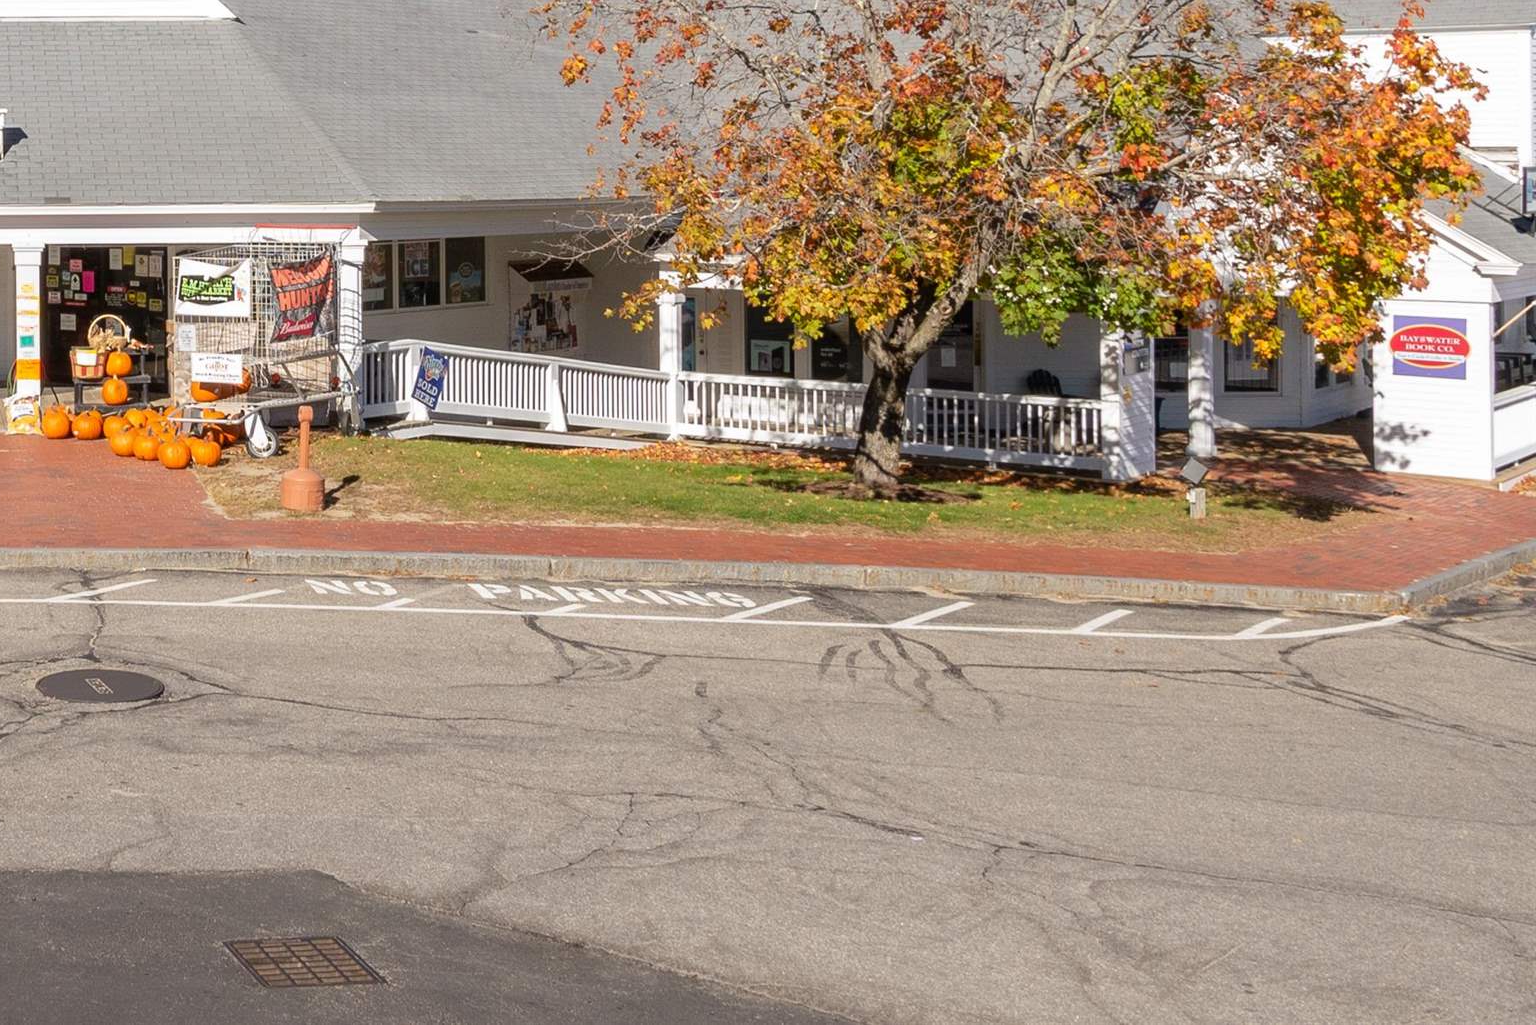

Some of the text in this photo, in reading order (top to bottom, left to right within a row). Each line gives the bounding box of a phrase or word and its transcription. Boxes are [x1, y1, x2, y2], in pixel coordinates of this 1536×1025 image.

[407, 259, 429, 275] ICE
[1400, 335, 1460, 345] BAYSWATER
[1406, 343, 1435, 352] BOOK
[417, 378, 439, 396] SOLD
[414, 388, 436, 407] HERE
[304, 579, 757, 608] NO PARKING
